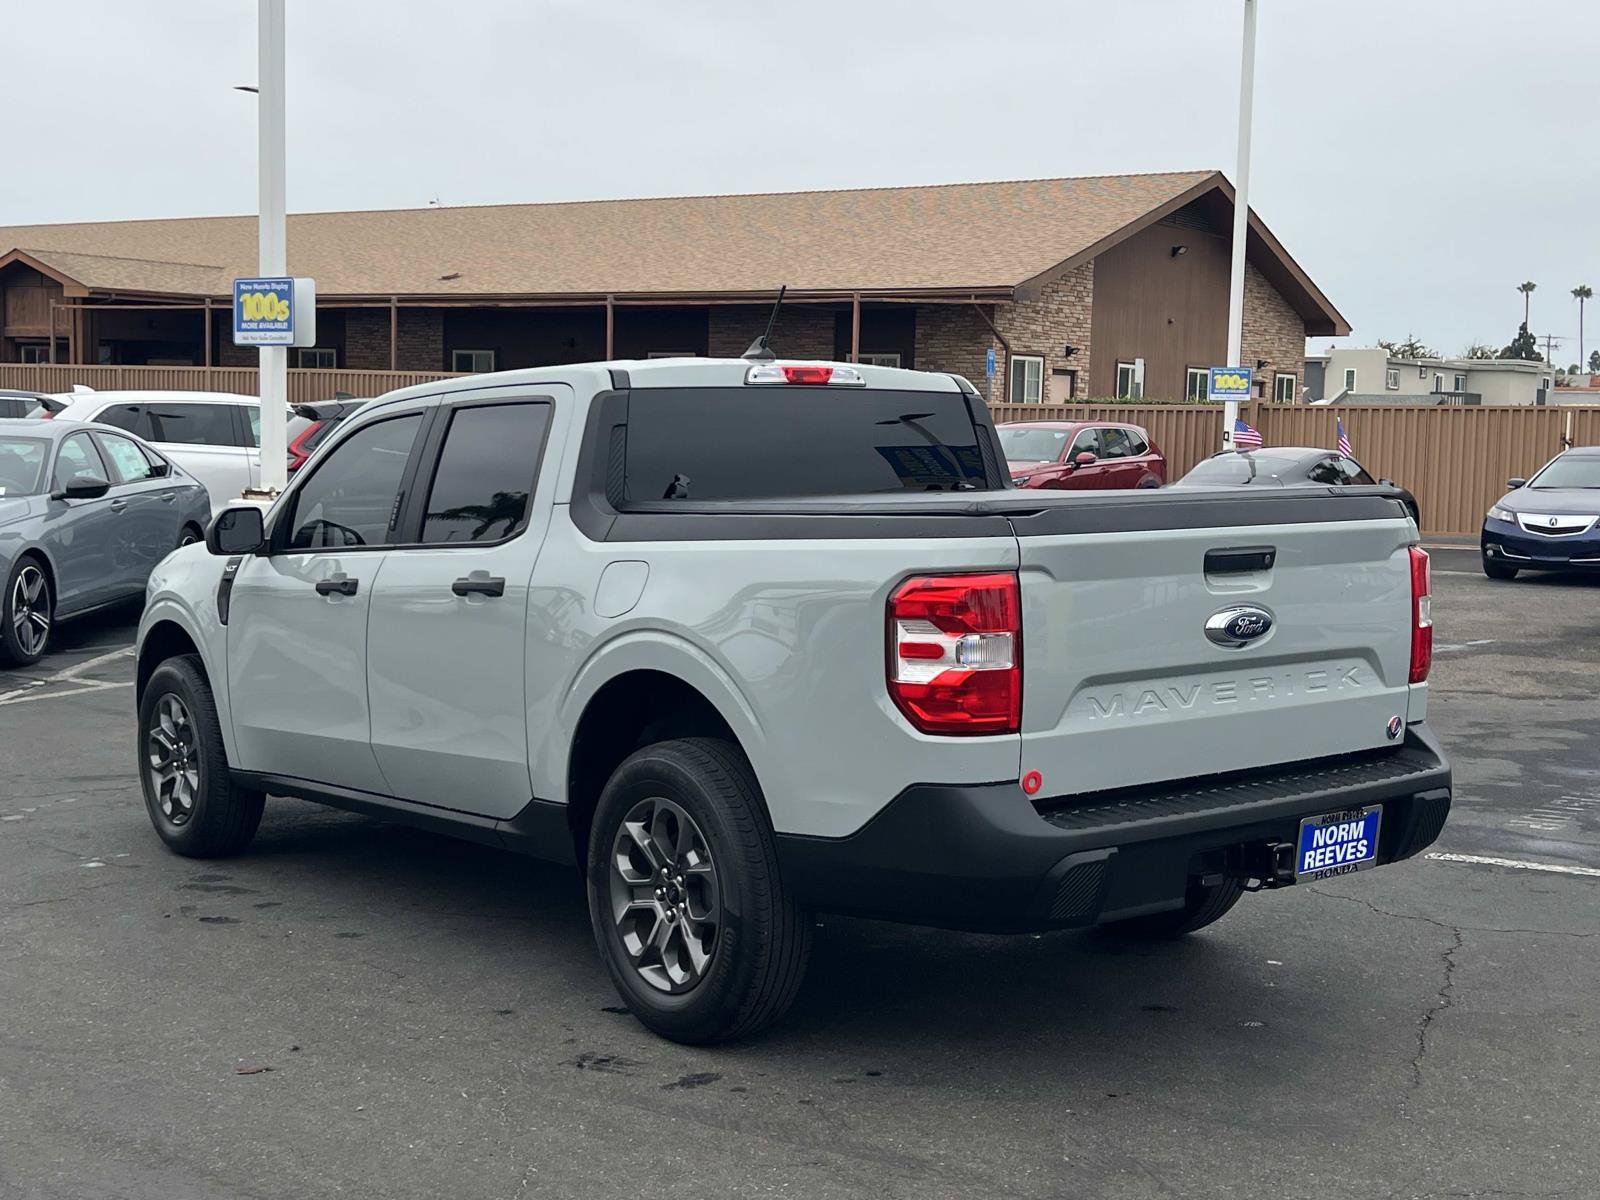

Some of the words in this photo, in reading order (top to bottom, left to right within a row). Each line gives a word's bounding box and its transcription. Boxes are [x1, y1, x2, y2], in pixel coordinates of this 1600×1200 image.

[239, 292, 290, 321] 100s
[1213, 374, 1249, 390] 100s
[1235, 616, 1264, 635] Ford
[1087, 665, 1361, 721] MAVERICK
[1312, 820, 1365, 848] NORM
[1303, 839, 1368, 870] REEVES
[1313, 862, 1359, 880] HONDA
